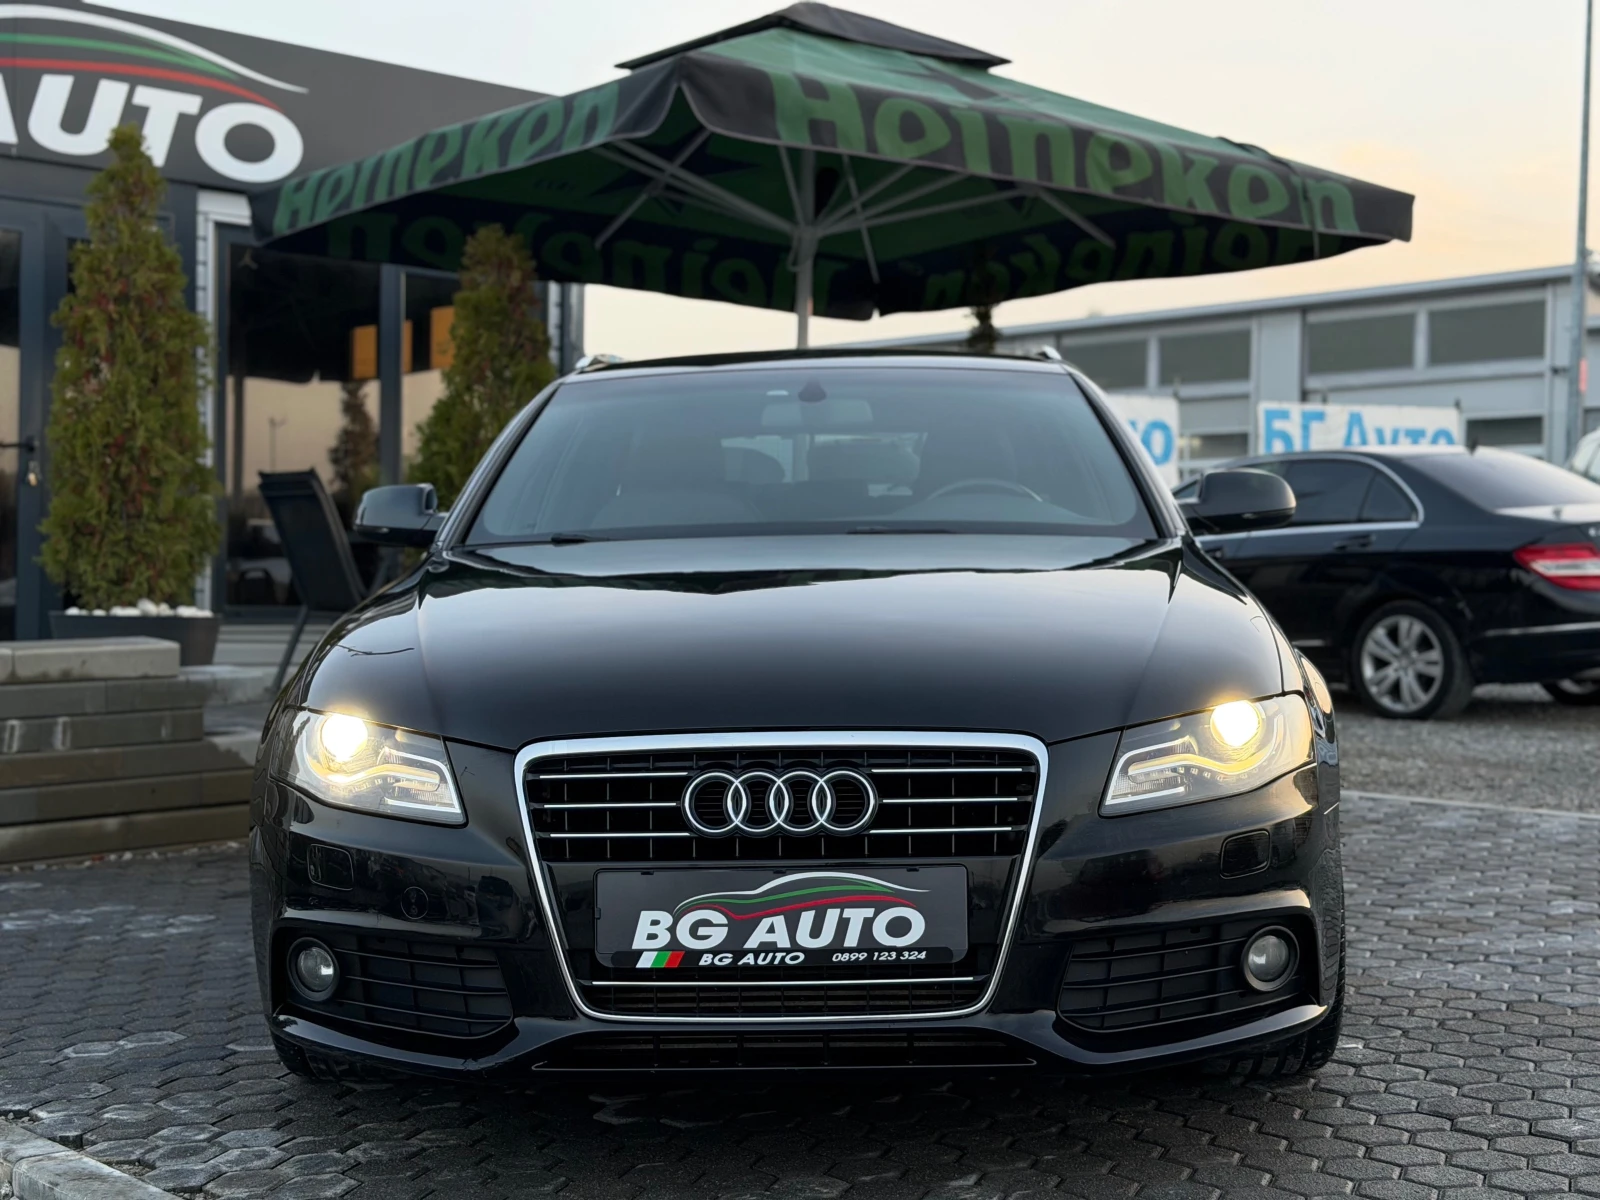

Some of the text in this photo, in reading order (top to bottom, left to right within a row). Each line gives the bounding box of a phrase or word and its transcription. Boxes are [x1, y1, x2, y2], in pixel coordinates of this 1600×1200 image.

[0, 73, 303, 183] UTO
[1264, 409, 1325, 454] БГ
[632, 907, 925, 949] BG AUTO
[699, 950, 927, 966] BG AUTO 0899 123 324
